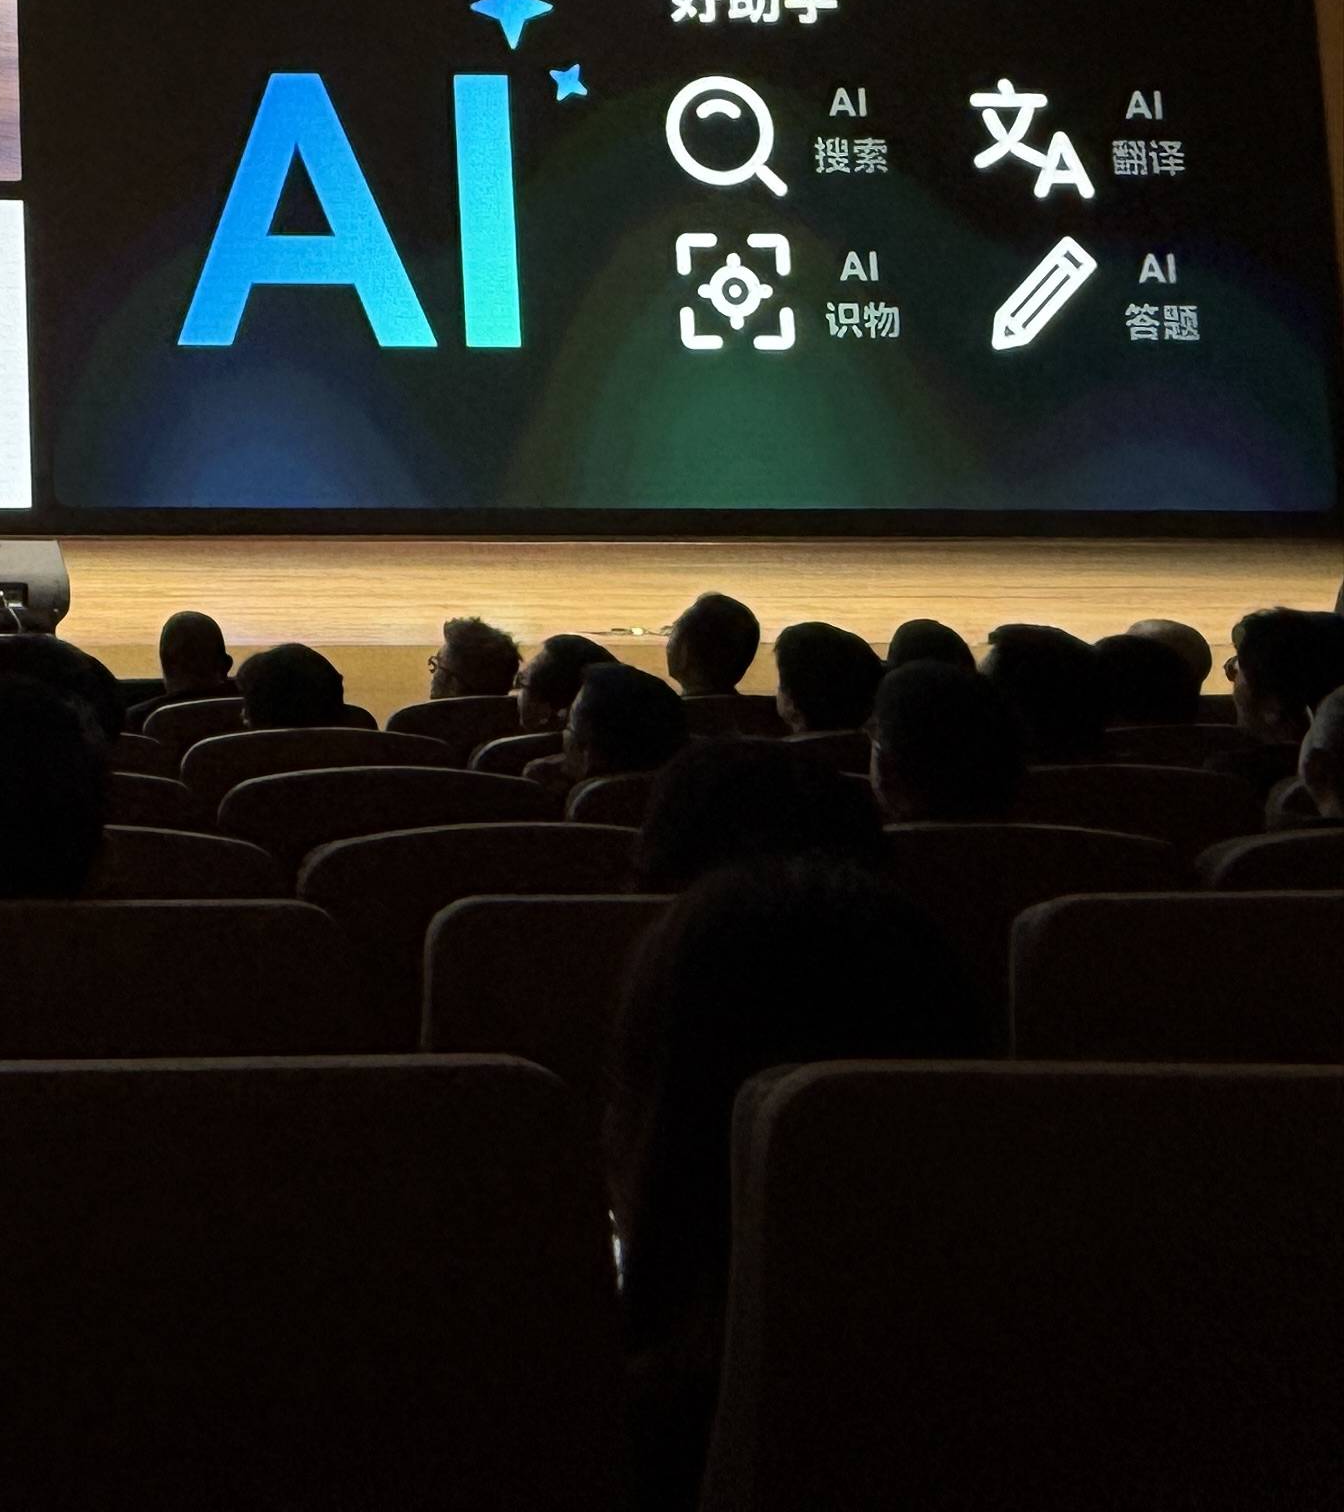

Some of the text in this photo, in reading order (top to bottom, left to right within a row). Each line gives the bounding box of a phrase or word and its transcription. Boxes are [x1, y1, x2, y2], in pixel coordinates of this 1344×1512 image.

[830, 88, 866, 116] AI
[1126, 91, 1162, 119] AI
[814, 137, 888, 173] 搜索
[1112, 140, 1185, 176] 翻译
[178, 73, 521, 348] AI
[840, 251, 878, 281] AI
[1139, 254, 1176, 283] AI
[826, 302, 899, 338] 识物
[1125, 304, 1200, 340] 答题
